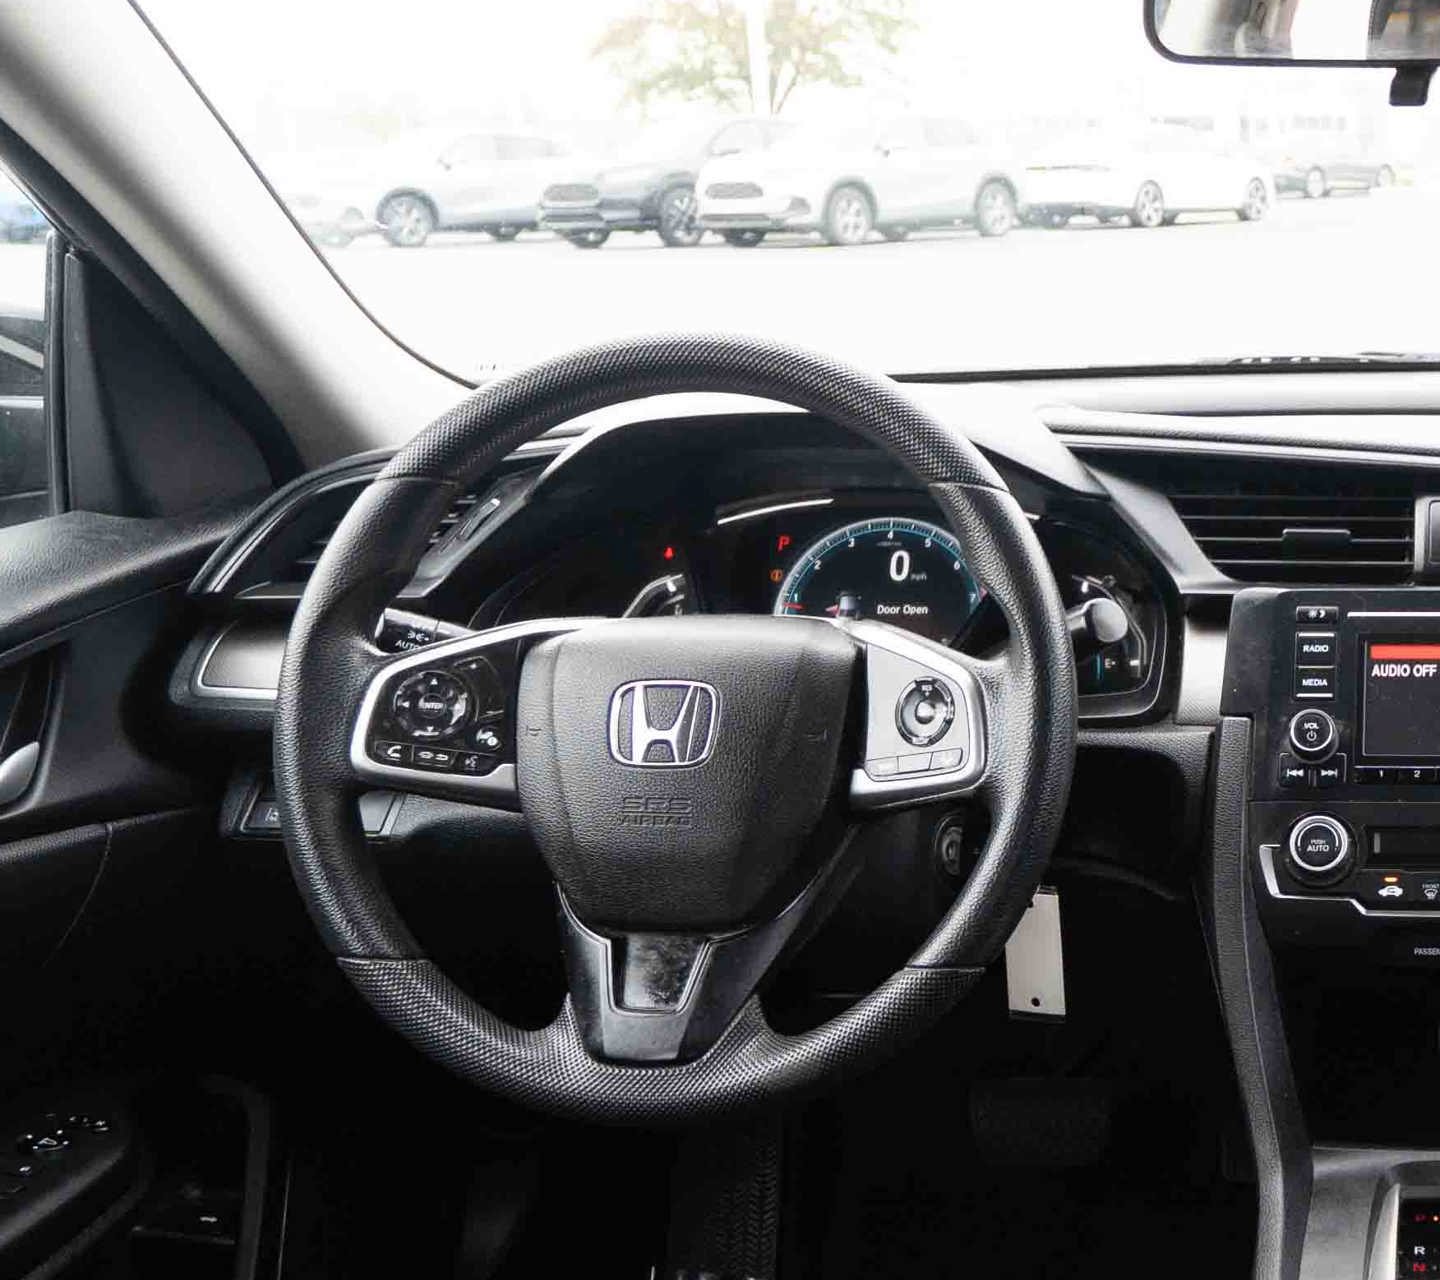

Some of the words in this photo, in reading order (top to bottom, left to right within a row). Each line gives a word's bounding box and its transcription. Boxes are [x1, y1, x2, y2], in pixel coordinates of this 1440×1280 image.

[777, 534, 791, 552] P
[847, 538, 856, 548] 3
[814, 560, 822, 571] 2
[889, 549, 911, 582] 0
[876, 604, 901, 615] Door
[902, 604, 929, 616] Open
[1302, 644, 1329, 653] RADIO
[1371, 663, 1411, 677] AUDIO
[1412, 663, 1438, 677] OFF
[1302, 678, 1328, 687] MEDIA
[1304, 722, 1320, 730] VOL
[1413, 770, 1421, 778] 2
[622, 796, 692, 814] SRS
[1306, 844, 1330, 852] AUTO
[1414, 1246, 1426, 1255] R
[1412, 1263, 1427, 1272] N
